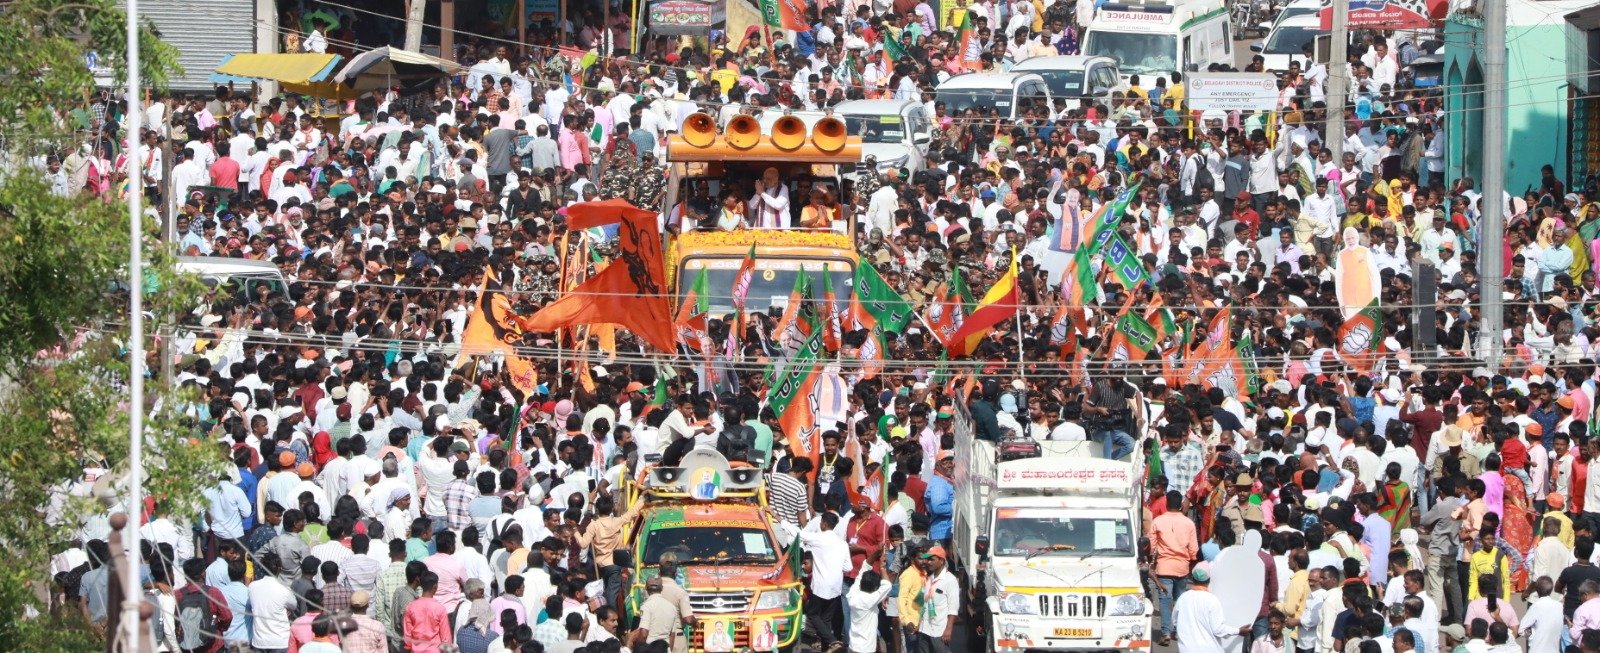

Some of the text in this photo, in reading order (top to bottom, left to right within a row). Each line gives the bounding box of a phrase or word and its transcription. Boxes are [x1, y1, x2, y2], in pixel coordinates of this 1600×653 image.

[1054, 628, 1092, 636] KA 23 B 5210
